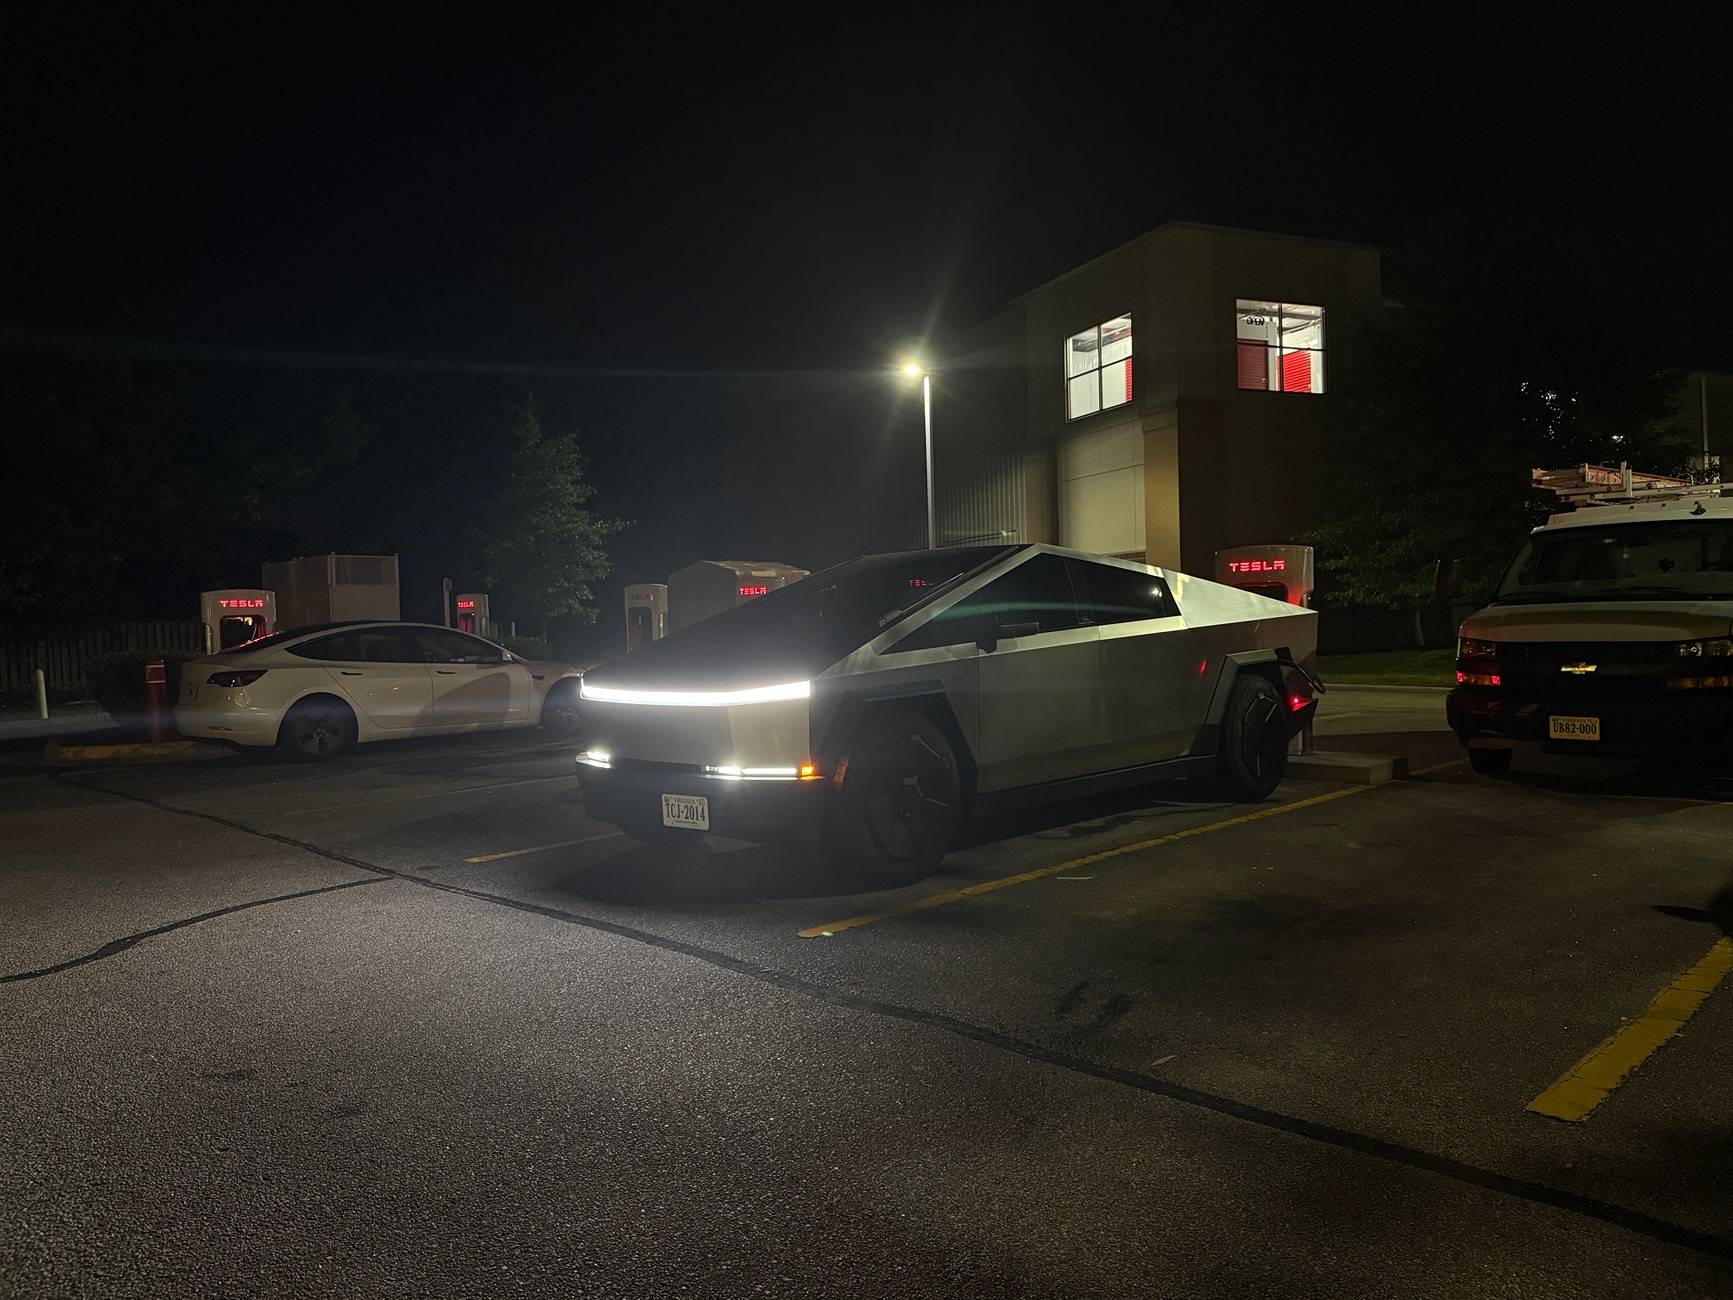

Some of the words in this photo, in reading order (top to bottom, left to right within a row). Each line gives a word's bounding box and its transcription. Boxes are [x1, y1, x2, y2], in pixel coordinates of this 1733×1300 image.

[1229, 560, 1285, 573] TESLA
[739, 586, 767, 596] TESLA
[219, 599, 263, 608] TESLA
[1553, 722, 1597, 735] UB82-000
